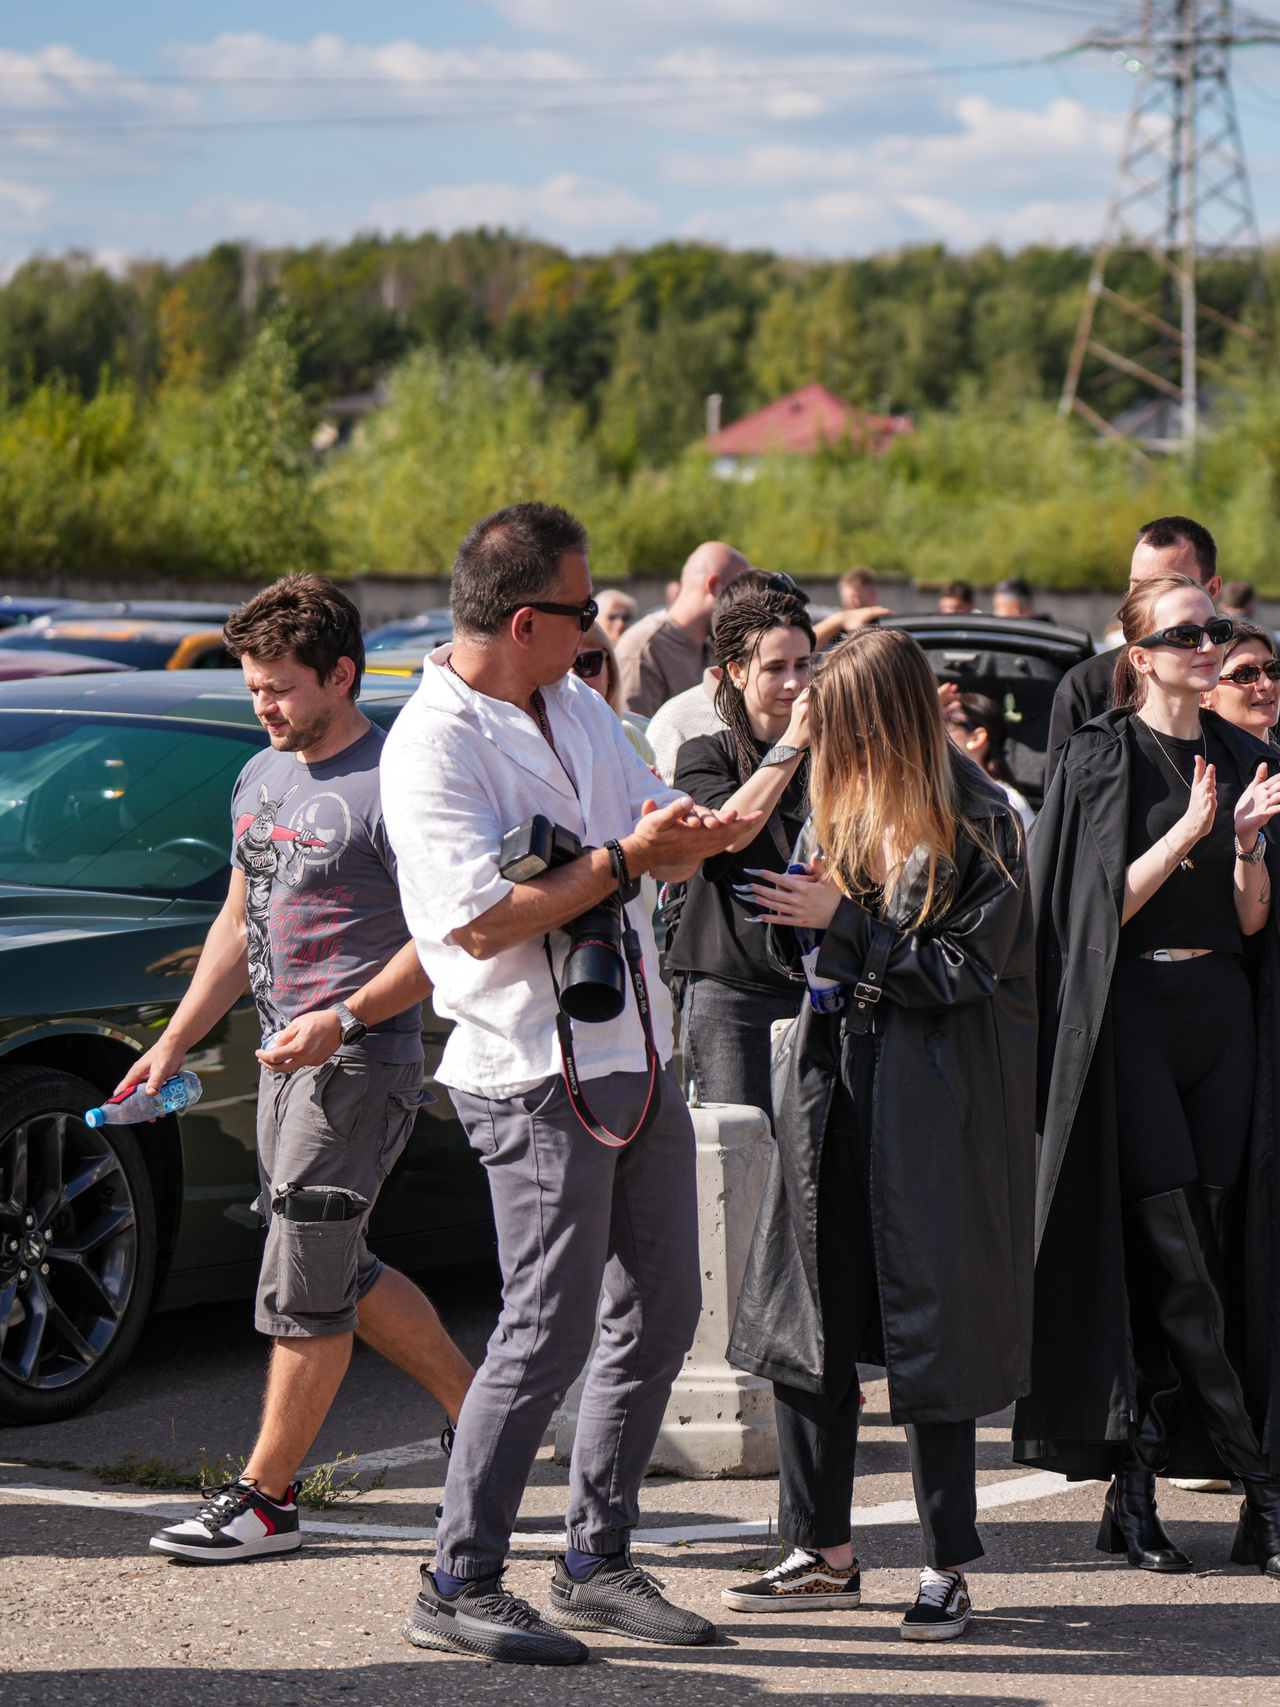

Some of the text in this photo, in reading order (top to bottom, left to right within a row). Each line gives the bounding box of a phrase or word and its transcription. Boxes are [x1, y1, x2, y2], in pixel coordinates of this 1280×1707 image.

[273, 885, 349, 912] RESPECT
[270, 907, 352, 940] POWER
[284, 934, 348, 971] HATE
[635, 973, 646, 999] EOS
